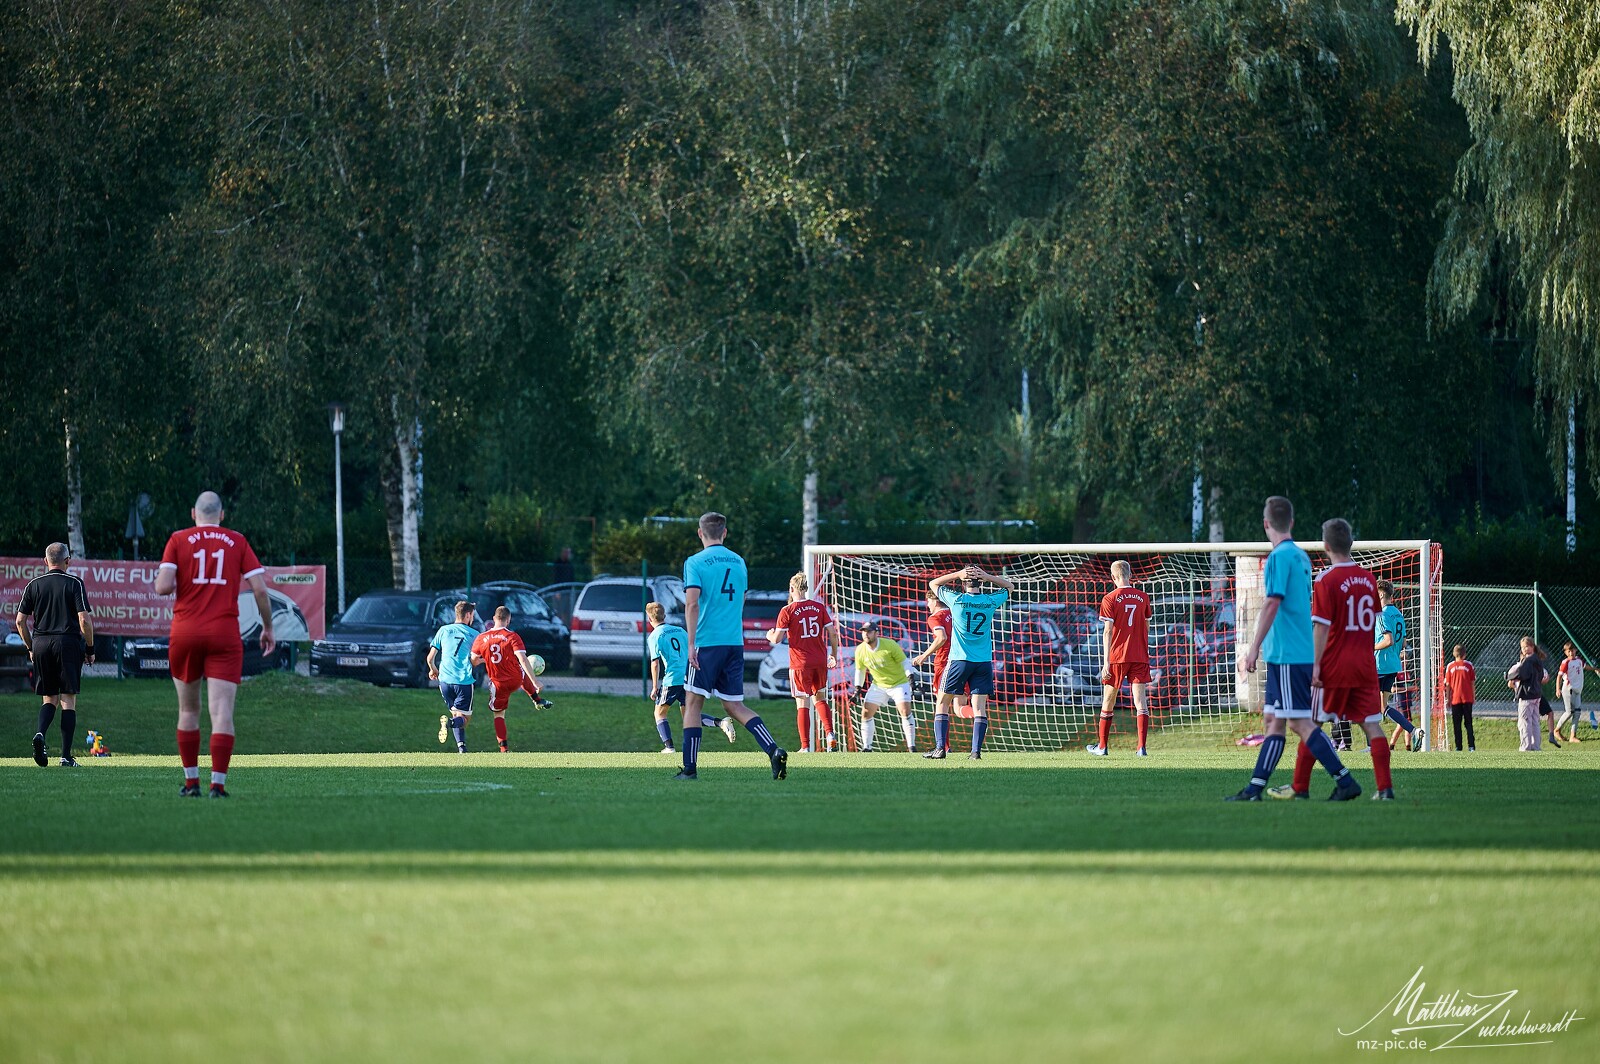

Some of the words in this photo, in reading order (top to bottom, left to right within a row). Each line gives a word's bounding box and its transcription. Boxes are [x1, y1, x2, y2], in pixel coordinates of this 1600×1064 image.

[187, 532, 201, 544] SV
[203, 531, 235, 547] Laufen
[92, 567, 125, 583] WIE
[192, 548, 227, 585] 11
[721, 568, 735, 601] 4
[1340, 580, 1351, 593] SV
[1349, 576, 1374, 592] Laufen
[1116, 595, 1124, 603] SV
[1124, 593, 1144, 603] Laufen
[88, 605, 135, 619] ANNST
[140, 607, 159, 619] DU
[163, 608, 173, 620] N
[794, 607, 802, 616] SV
[801, 605, 820, 613] Laufen
[1124, 604, 1137, 627] 7
[1345, 595, 1375, 632] 16
[798, 616, 820, 639] 15
[965, 611, 987, 635] 12
[1395, 622, 1403, 643] 8
[454, 636, 464, 657] 7
[490, 644, 502, 664] 3
[671, 637, 681, 657] 9
